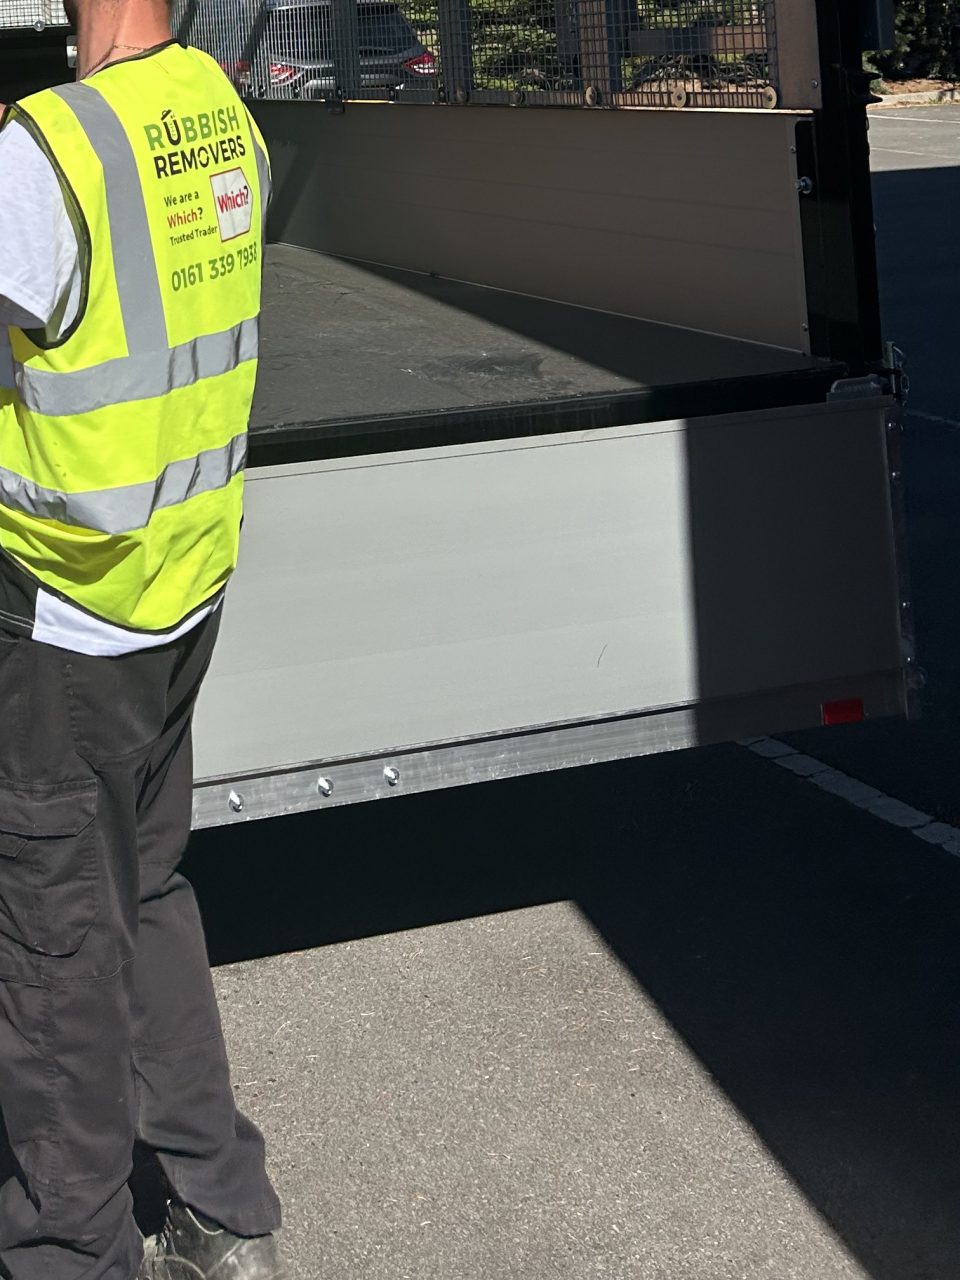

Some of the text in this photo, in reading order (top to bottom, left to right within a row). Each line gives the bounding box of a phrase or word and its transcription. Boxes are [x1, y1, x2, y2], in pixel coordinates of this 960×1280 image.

[143, 105, 240, 151] RUBBISH
[153, 135, 246, 179] REMOVERS
[164, 191, 200, 207] We are a
[217, 185, 249, 214] Which?
[167, 207, 203, 229] Which?
[169, 225, 218, 247] Trusted Trader
[171, 262, 204, 292] 0161
[208, 253, 235, 280] 339
